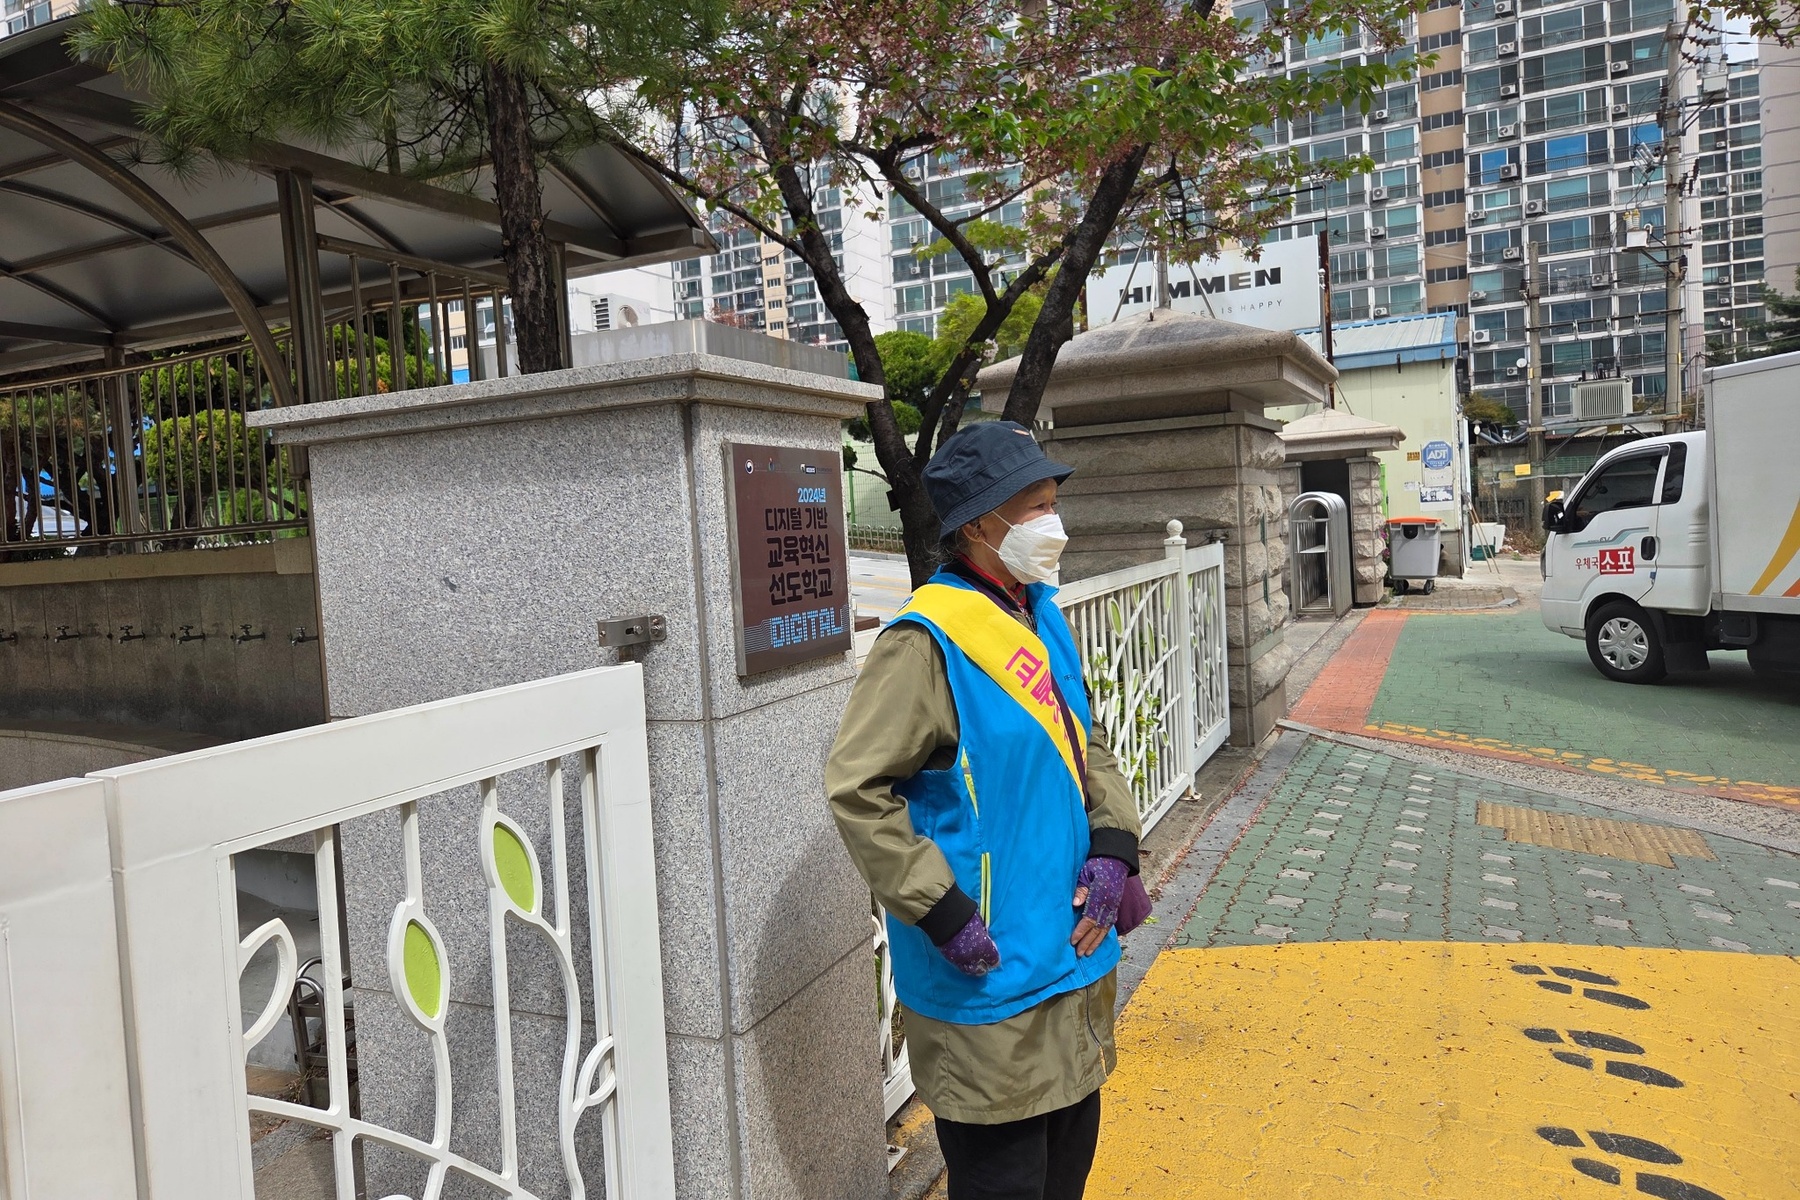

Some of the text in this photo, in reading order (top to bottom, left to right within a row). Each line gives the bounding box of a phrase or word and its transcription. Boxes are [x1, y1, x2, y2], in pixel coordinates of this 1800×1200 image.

[1119, 267, 1281, 305] HIMMEN
[1221, 306, 1233, 314] IS
[1240, 299, 1283, 312] HAPPY
[1426, 449, 1448, 460] ADT
[797, 487, 827, 503] 2024년
[765, 507, 828, 532] 디지털 기반
[766, 534, 830, 568] 교육혁신
[1575, 550, 1633, 572] 우체국 소포
[769, 568, 833, 605] 선도학교
[770, 607, 844, 648] DIGITAL
